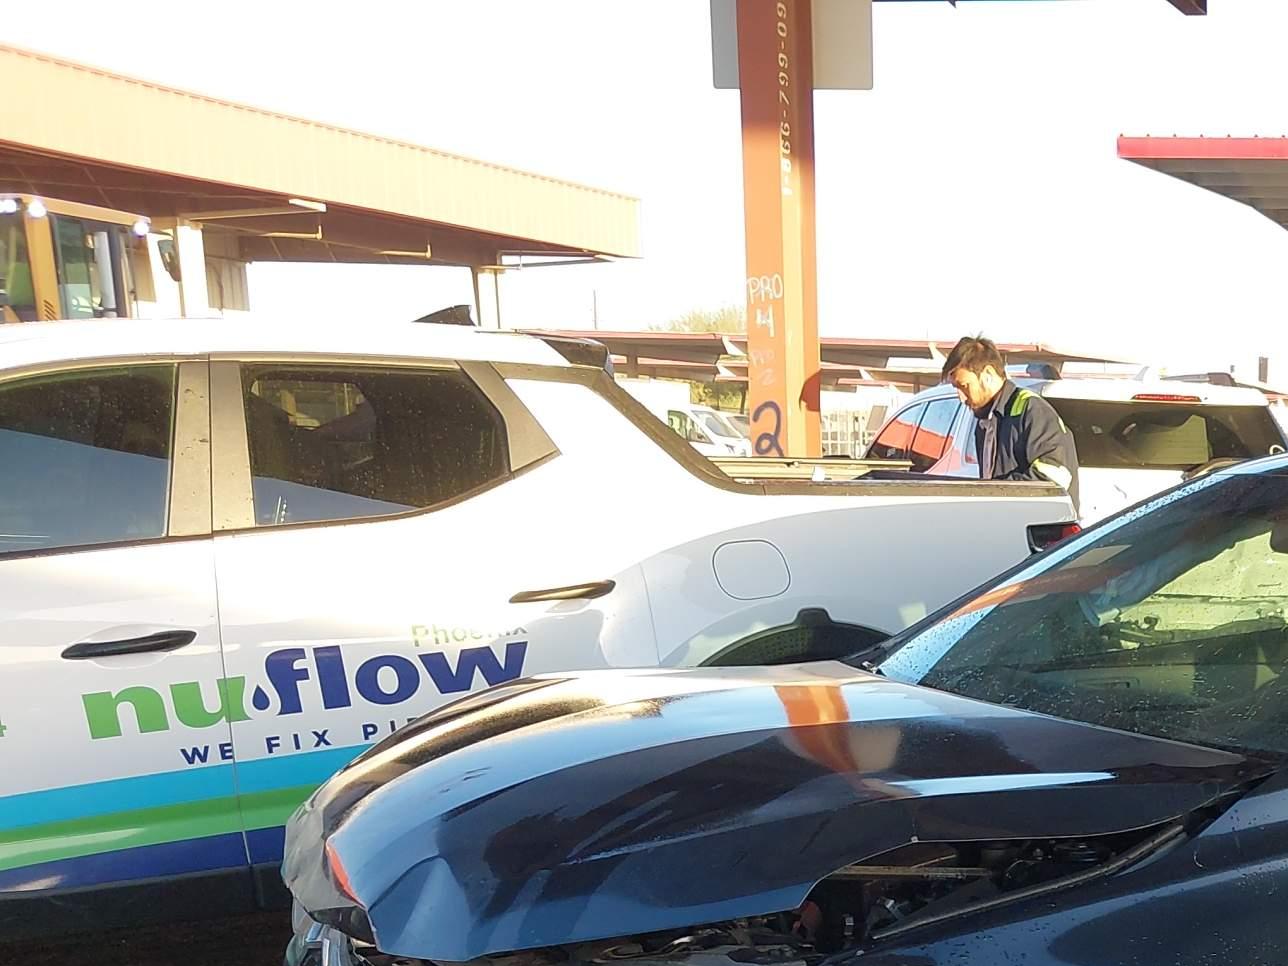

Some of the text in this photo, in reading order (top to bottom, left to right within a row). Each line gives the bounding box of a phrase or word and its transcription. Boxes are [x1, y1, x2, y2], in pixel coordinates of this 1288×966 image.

[747, 274, 784, 304] PRO
[756, 304, 775, 337] 4
[752, 400, 785, 457] 2
[412, 624, 528, 648] Phoex
[180, 742, 236, 765] WE
[266, 729, 331, 754] FIX
